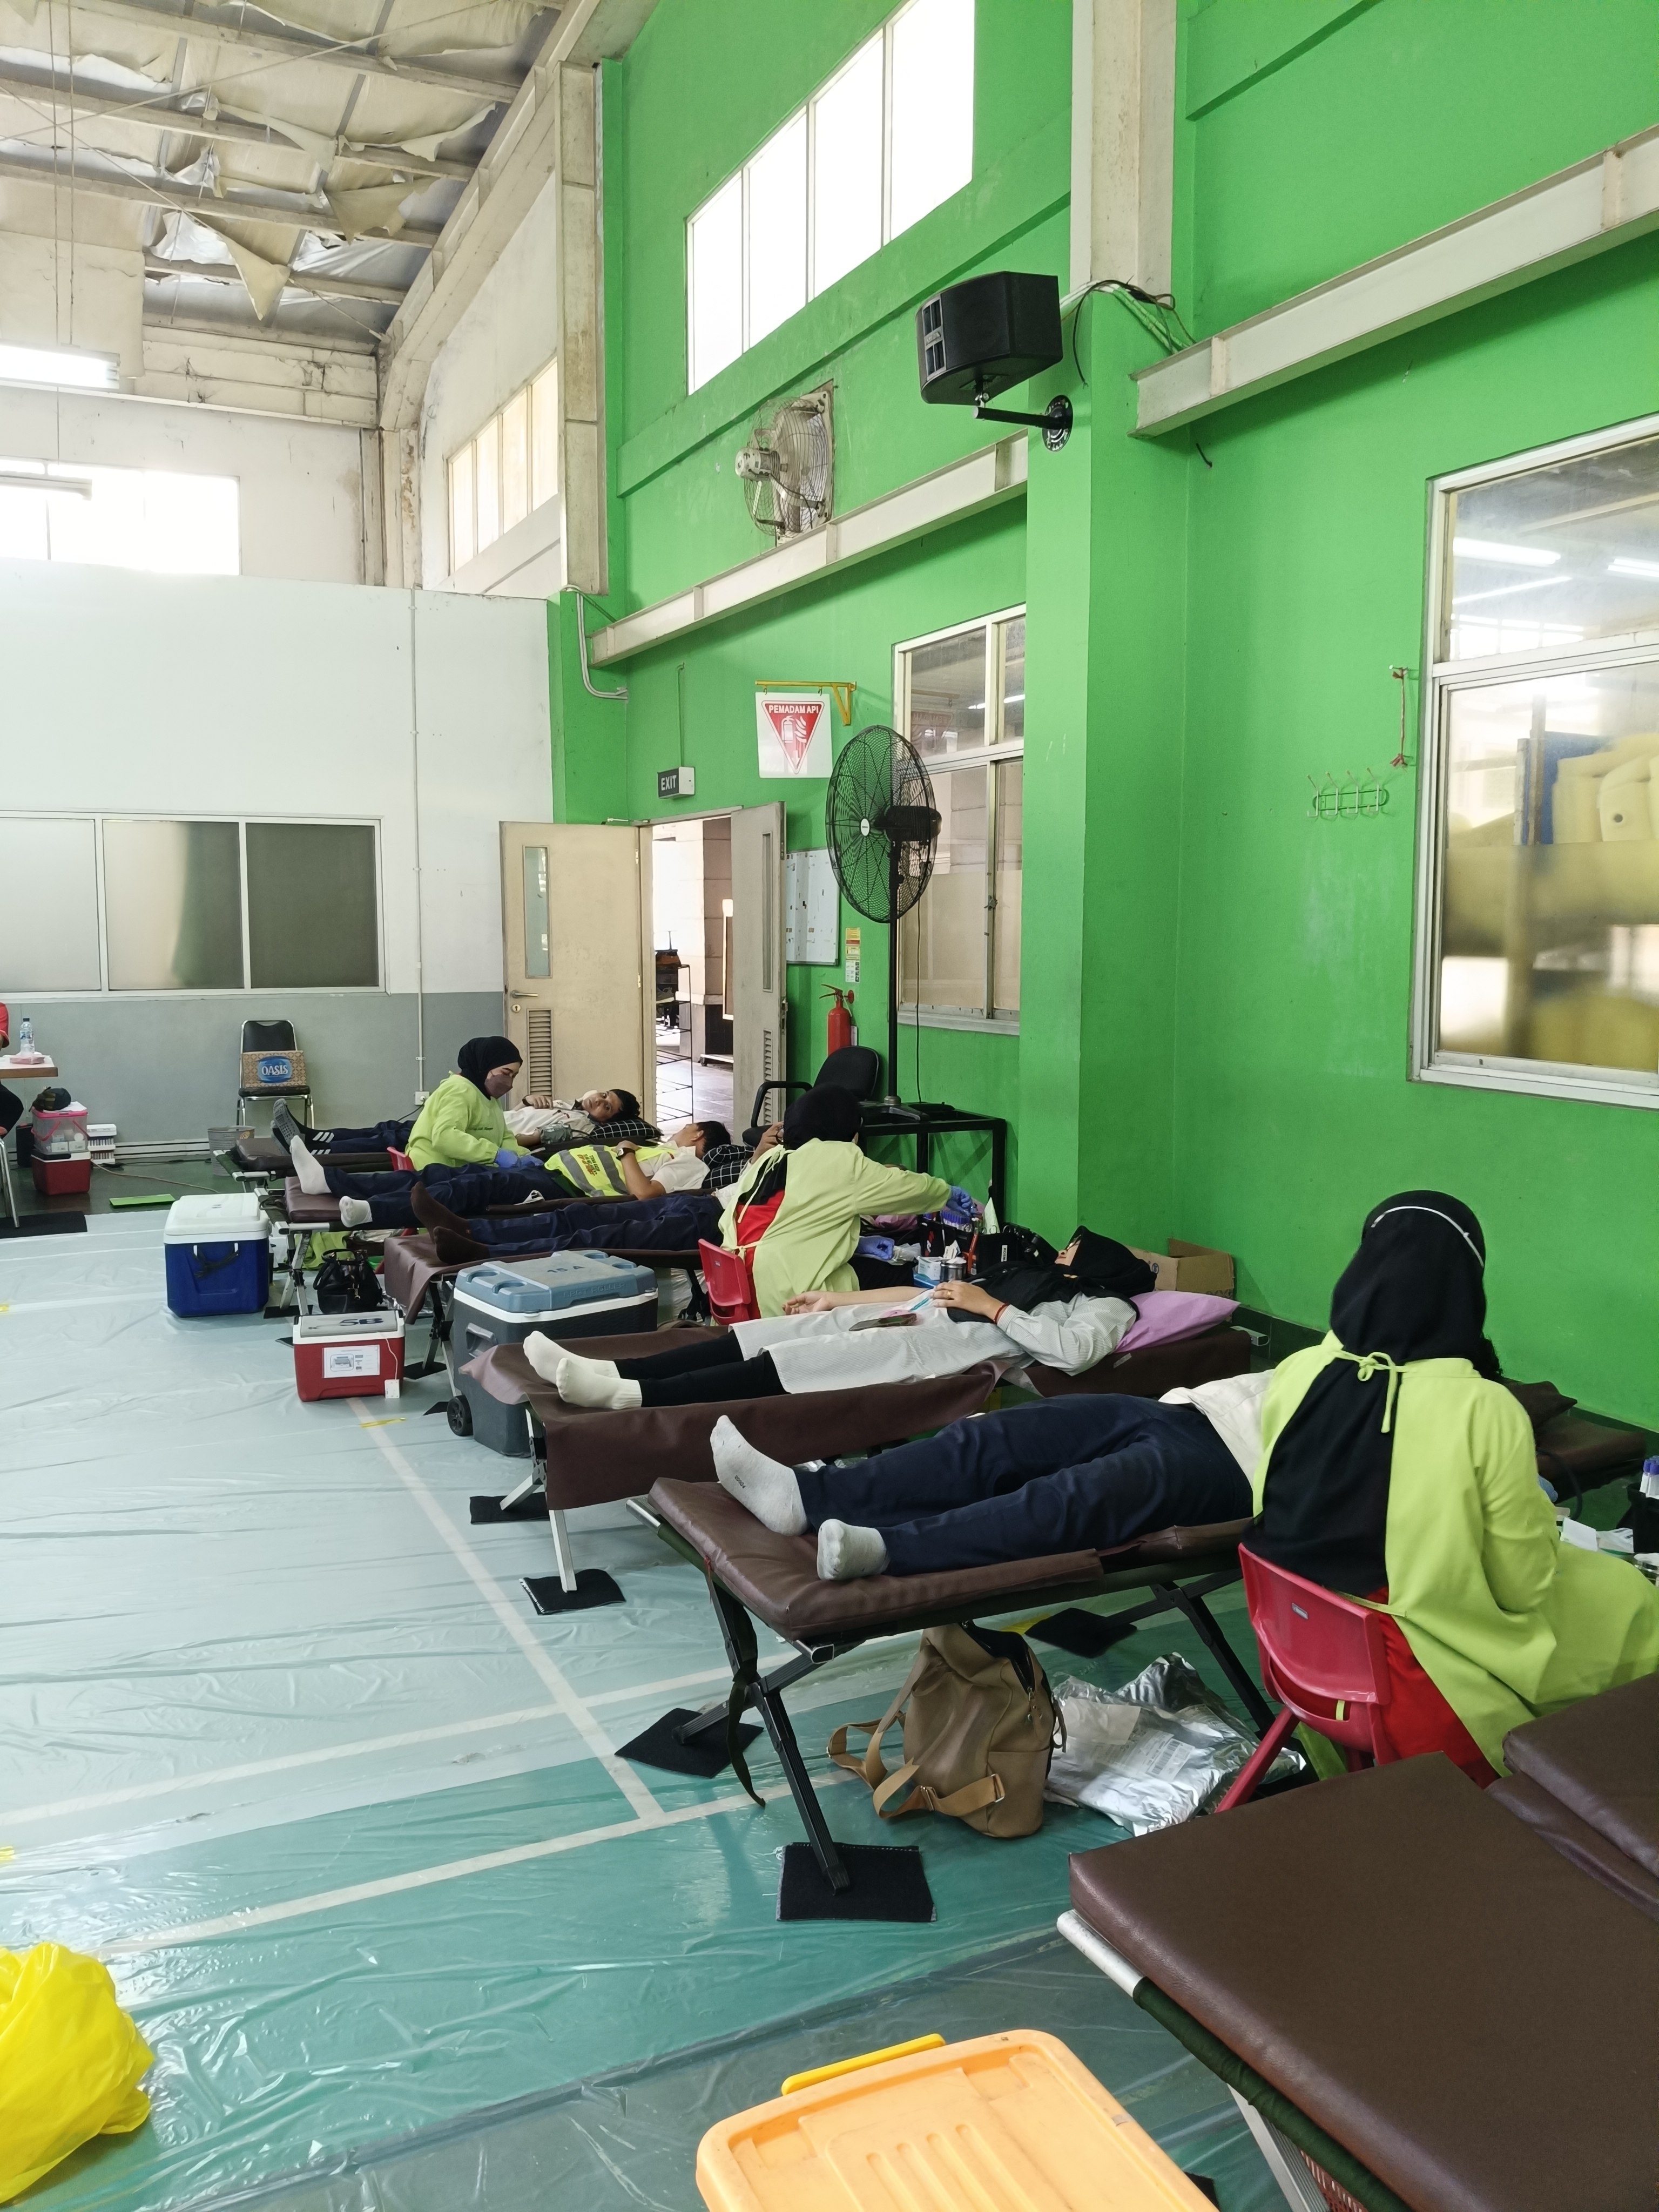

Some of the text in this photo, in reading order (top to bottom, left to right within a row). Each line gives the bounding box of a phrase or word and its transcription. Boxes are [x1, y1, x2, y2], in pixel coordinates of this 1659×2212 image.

[768, 705, 819, 713] PEMADAM API
[661, 774, 677, 791] EXIT
[261, 1064, 288, 1075] OASIS
